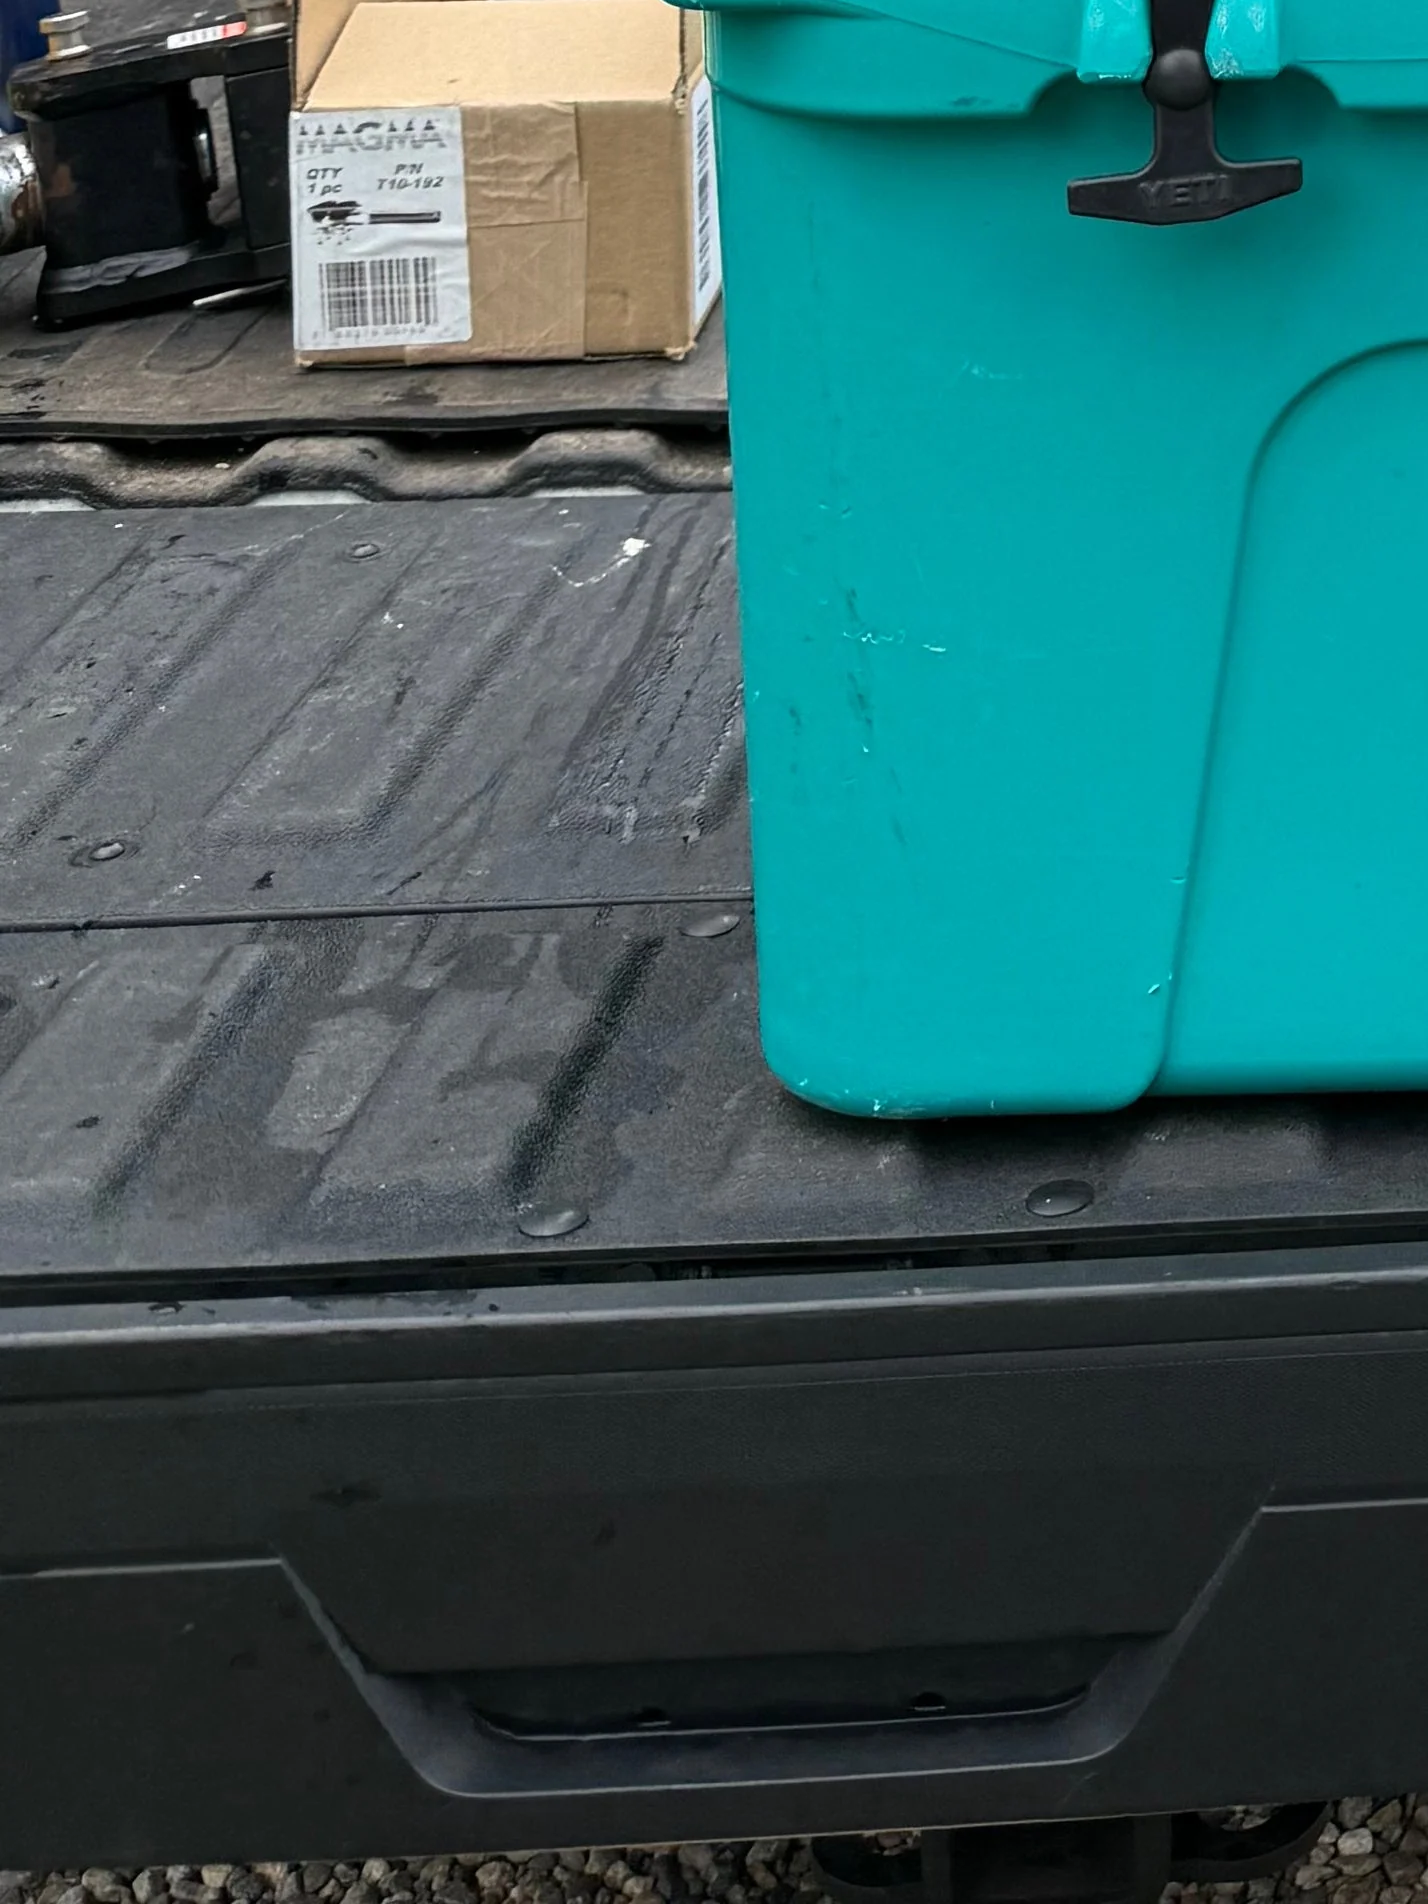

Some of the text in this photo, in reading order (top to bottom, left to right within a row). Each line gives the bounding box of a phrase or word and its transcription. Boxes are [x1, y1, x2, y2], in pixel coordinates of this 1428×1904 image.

[295, 118, 448, 156] MAGMA
[306, 166, 344, 181] QTY
[1139, 173, 1230, 208] YETI
